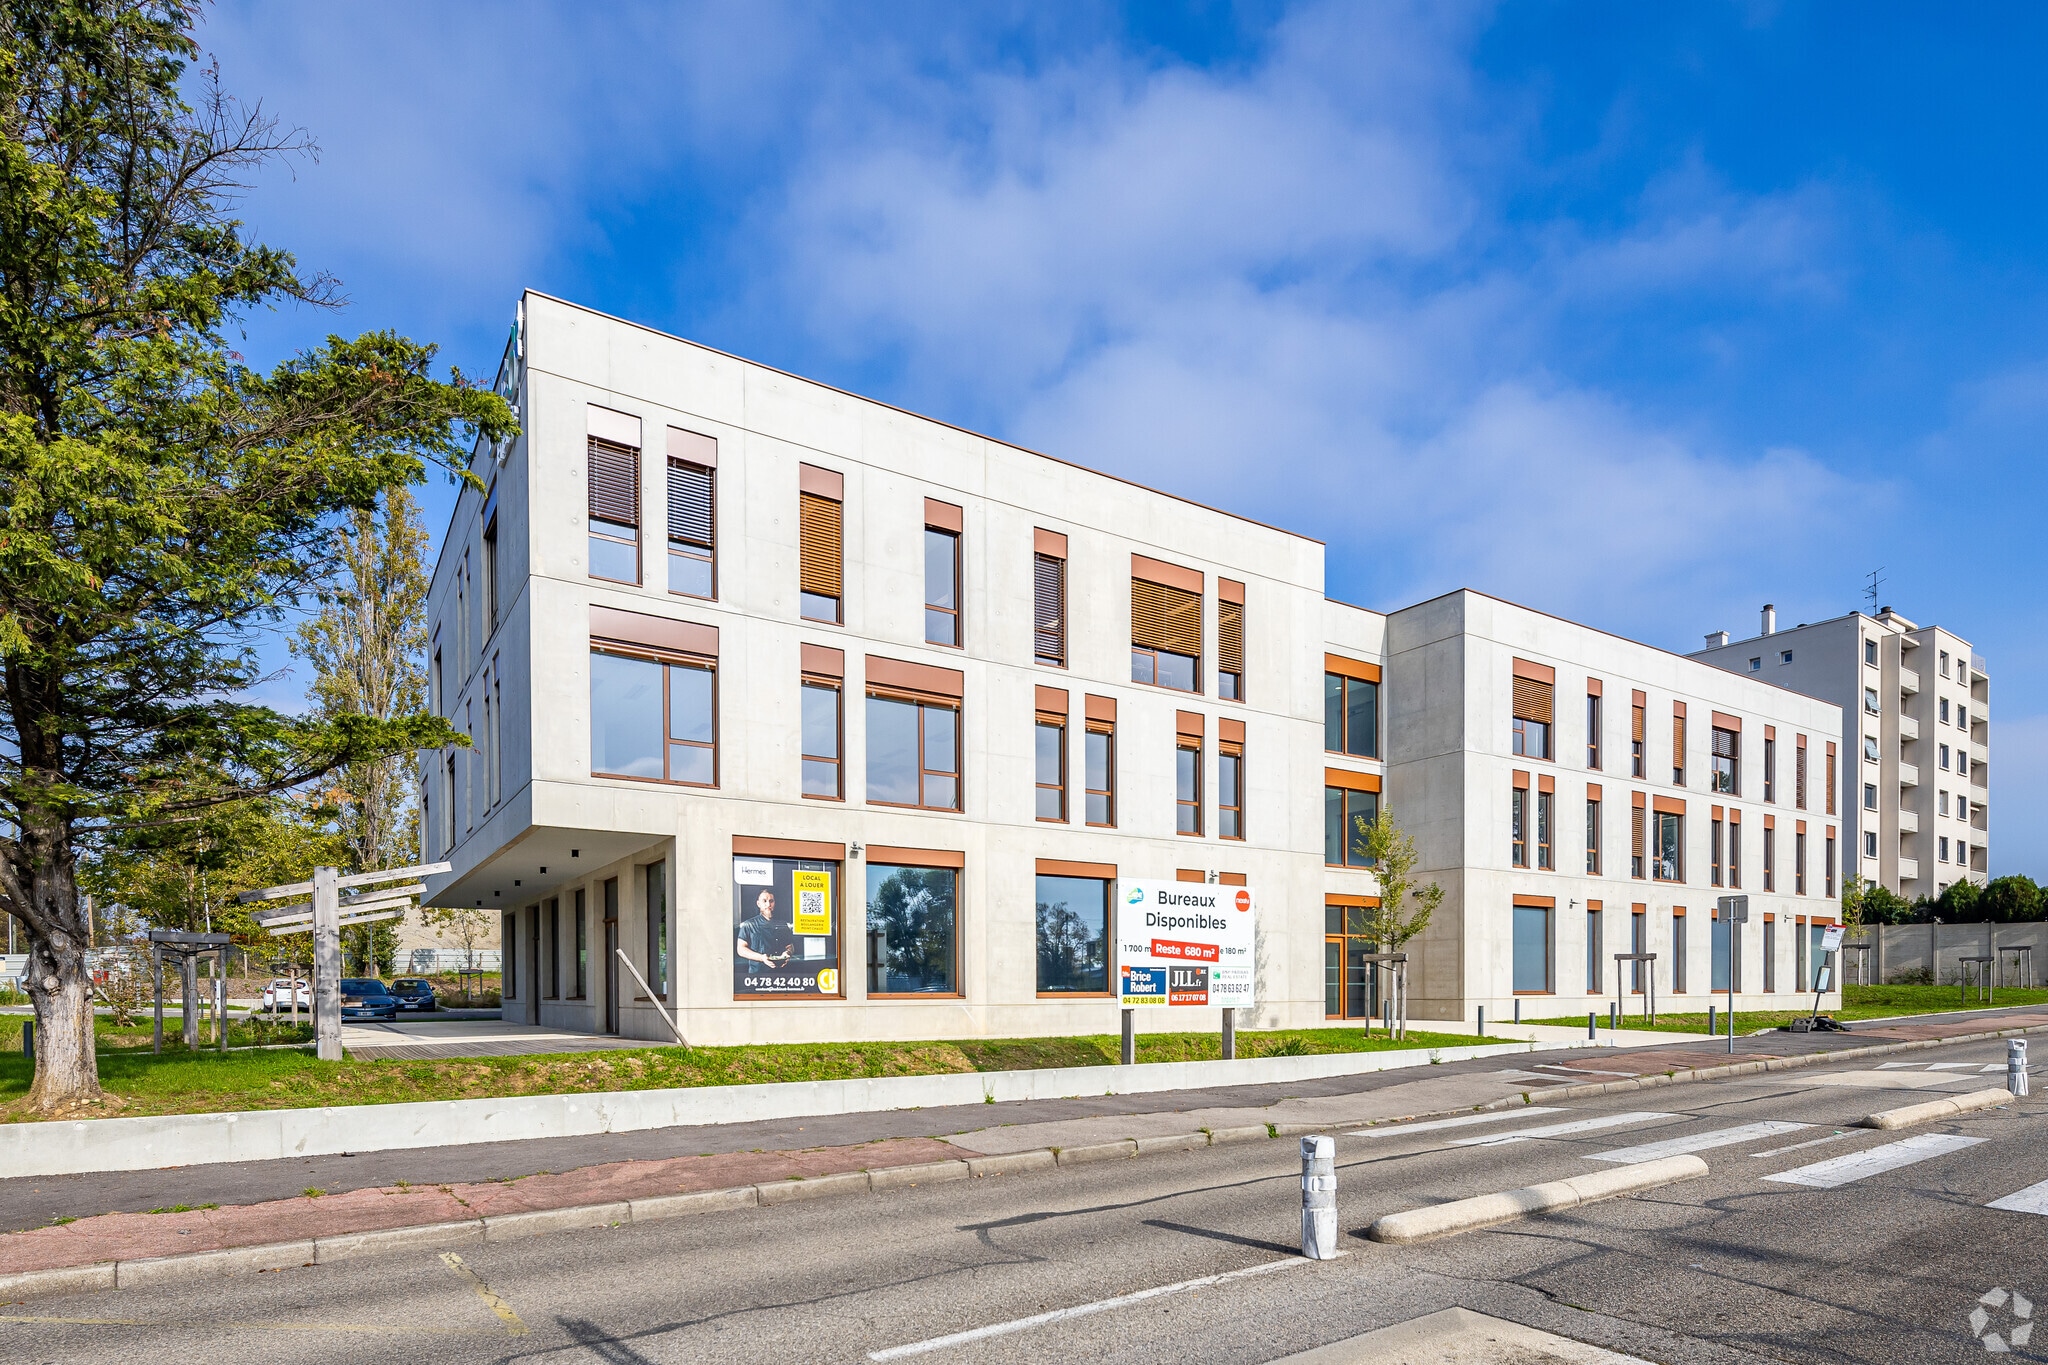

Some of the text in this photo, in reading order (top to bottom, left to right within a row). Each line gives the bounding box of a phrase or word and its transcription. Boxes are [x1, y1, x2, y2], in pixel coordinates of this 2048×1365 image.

[742, 866, 766, 875] Hermes
[1158, 891, 1216, 908] Bureaux
[1146, 912, 1226, 930] Disponibles
[1124, 944, 1127, 952] 1
[1129, 944, 1143, 952] 700
[1156, 944, 1216, 958] Reste 680 m²
[1225, 947, 1236, 955] 180
[1130, 970, 1151, 981] Brice
[744, 978, 815, 986] 04 78 42 40 80
[1130, 982, 1156, 992] Robert
[1213, 984, 1219, 993] 04
[1220, 984, 1227, 993] 78
[1132, 996, 1139, 1004] 72
[1141, 996, 1148, 1004] 83
[1149, 996, 1157, 1004] 08
